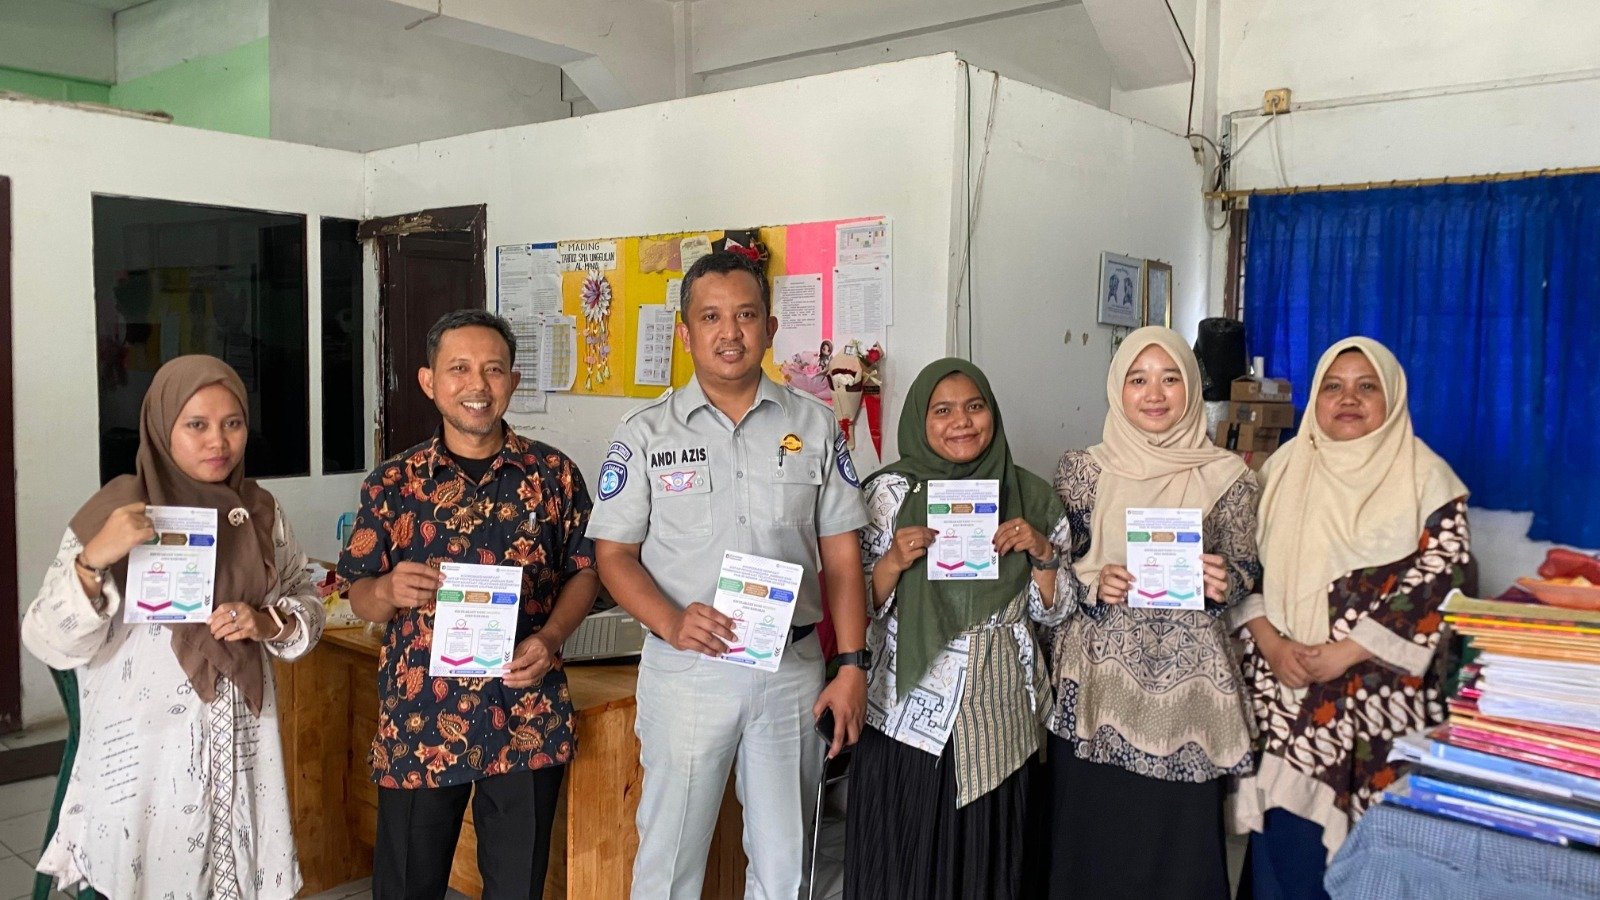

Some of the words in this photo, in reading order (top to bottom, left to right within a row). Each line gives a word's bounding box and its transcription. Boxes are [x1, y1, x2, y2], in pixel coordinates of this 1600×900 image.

[568, 242, 600, 252] MADING
[578, 253, 589, 262] SMA
[590, 251, 615, 262] UNGGULAN
[651, 451, 676, 468] ANDI
[681, 448, 707, 463] AZIS
